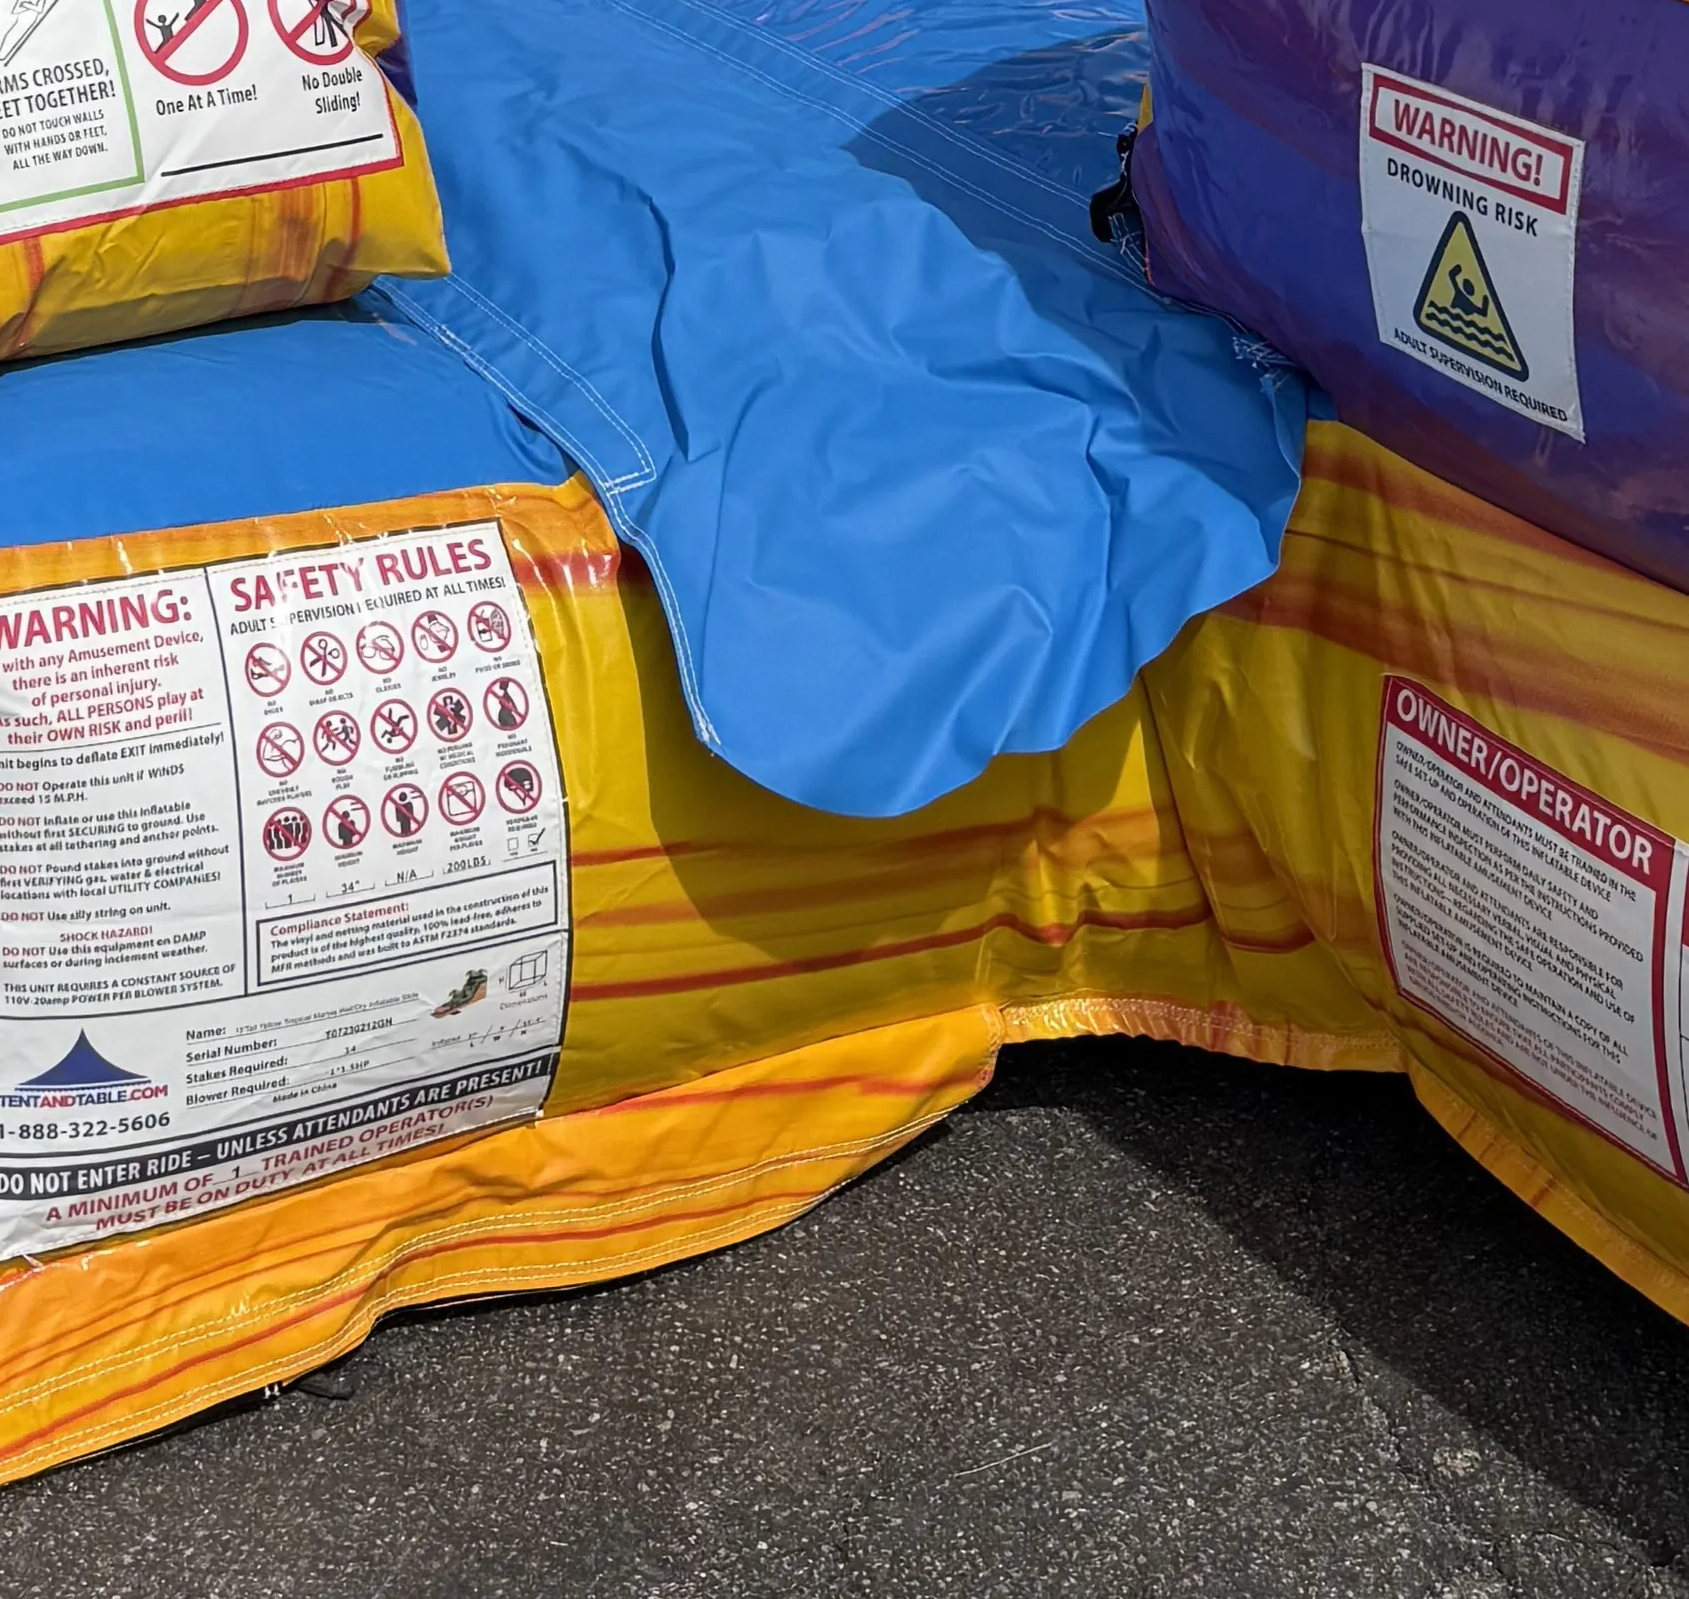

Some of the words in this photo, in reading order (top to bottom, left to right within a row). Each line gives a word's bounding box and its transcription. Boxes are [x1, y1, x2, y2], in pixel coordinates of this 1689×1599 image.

[32, 58, 109, 87] CROSSED,
[301, 74, 319, 91] No
[321, 66, 363, 88] Double
[23, 79, 116, 113] TOGETHER!
[155, 99, 184, 116] One
[187, 94, 203, 111] At
[206, 90, 216, 107] A
[216, 83, 257, 105] Time!
[315, 91, 360, 114] Sliding!
[1, 126, 16, 139] DO
[17, 121, 37, 136] NOT
[38, 114, 71, 130] TOUCH
[72, 109, 104, 124] WALLS
[3, 140, 31, 155] WITH
[32, 133, 66, 148] HANDS
[67, 130, 82, 142] OR
[82, 125, 107, 138] FEET,
[12, 158, 30, 170] ALL
[31, 152, 51, 166] THE
[51, 148, 72, 162] WAY
[75, 142, 108, 157] DOWN.
[1394, 99, 1543, 187] WARNING!
[1387, 157, 1487, 216] DROWNING
[1494, 202, 1538, 237] RISK
[1393, 327, 1427, 355] ADULT
[1428, 346, 1503, 394] SUPERVISION
[1503, 385, 1568, 422] REQUIRED
[376, 538, 492, 586] RULES
[230, 618, 266, 635] ADULT
[425, 586, 438, 599] AT
[443, 582, 465, 596] ALL
[464, 576, 506, 593] TIMES!
[1, 656, 35, 673] with
[38, 654, 64, 668] any
[67, 638, 151, 663] Amusement
[153, 631, 203, 648] Device,
[11, 676, 51, 691] there
[55, 671, 67, 685] is
[70, 670, 87, 682] an
[90, 658, 150, 679] inherent
[153, 652, 179, 668] risk
[11, 712, 52, 727] such,
[56, 707, 84, 723] ALL
[87, 697, 154, 719] PERSONS
[157, 692, 186, 710] play
[189, 687, 204, 701] at
[30, 692, 46, 707] of
[50, 683, 113, 708] personal
[116, 677, 161, 695] injury.
[7, 731, 43, 745] their
[46, 725, 85, 742] OWN
[88, 720, 121, 737] RISK
[124, 715, 152, 732] and
[155, 707, 192, 730] peril!
[16, 757, 58, 769] begins
[60, 756, 73, 766] to
[75, 750, 118, 765] deflate
[120, 745, 145, 759] EXIT
[15, 781, 39, 791] NOT
[41, 779, 87, 791] Operate
[89, 775, 110, 787] this
[112, 772, 134, 784] unit
[136, 769, 144, 781] if
[147, 763, 184, 779] WINDS
[1396, 689, 1652, 875] OWNER/OPERATOR
[1, 911, 19, 922] DO
[20, 911, 44, 921] NOT
[46, 911, 67, 921] Use
[94, 906, 127, 918] string
[128, 906, 143, 915] on
[269, 916, 341, 936] Compliance
[343, 902, 409, 923] Statement:
[185, 1026, 226, 1041] Name:
[185, 1046, 221, 1062] Serial
[223, 1038, 277, 1056] Number:
[185, 1069, 226, 1084] Stakes
[228, 1055, 288, 1076] Required:
[185, 1090, 228, 1105] Blower
[231, 1075, 293, 1097] Required:
[30, 1171, 71, 1194] NOT
[77, 1163, 141, 1190] ENTER
[147, 1150, 193, 1178] RIDE
[217, 1124, 287, 1160] UNLESS
[293, 1097, 410, 1142] ATTENDANTS
[414, 1082, 450, 1105] ARE
[455, 1060, 543, 1095] PRESENT!
[45, 1206, 62, 1222] A
[68, 1181, 178, 1219] MINIMUM
[184, 1172, 214, 1192] OF
[261, 1134, 353, 1171] TRAINED
[358, 1094, 493, 1144] OPERATOR(S)
[96, 1206, 159, 1231] MUST
[165, 1196, 192, 1215] BE
[197, 1187, 230, 1205] ON
[235, 1170, 291, 1194] DUTY
[302, 1158, 328, 1176] AT
[329, 1146, 370, 1168] ALL
[376, 1124, 445, 1152] TIMES!
